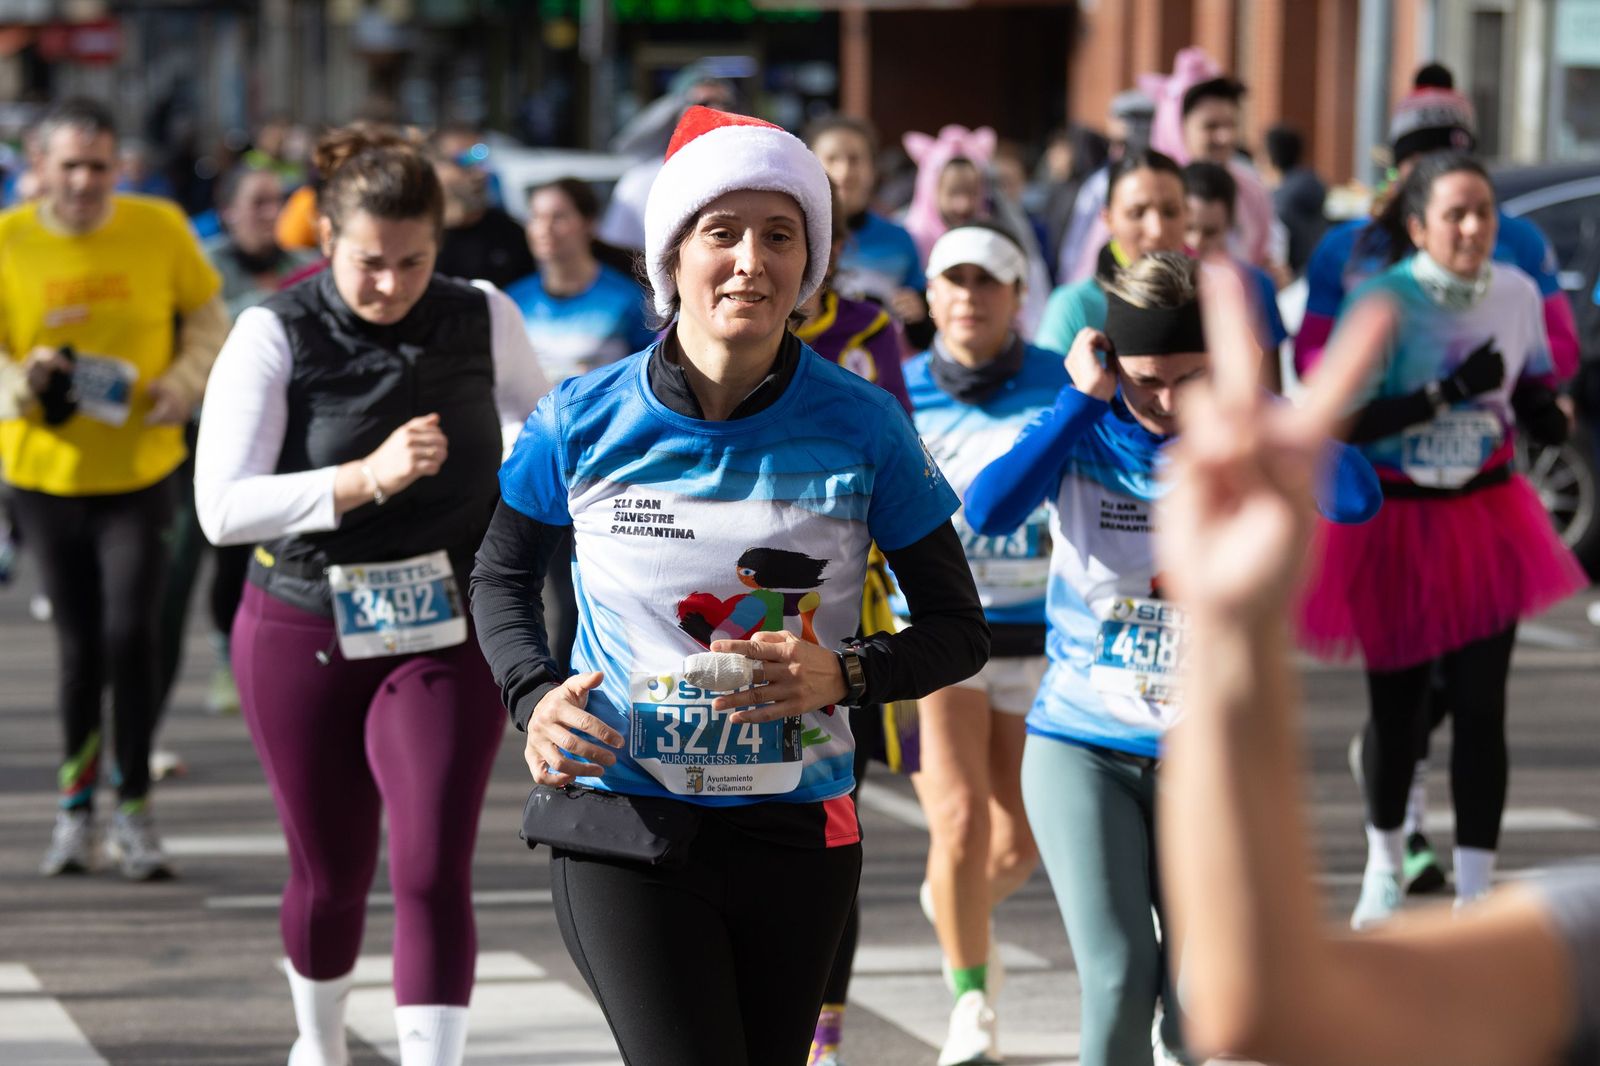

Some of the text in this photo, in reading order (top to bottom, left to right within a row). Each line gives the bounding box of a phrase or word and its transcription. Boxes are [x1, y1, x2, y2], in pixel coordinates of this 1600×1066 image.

[613, 499, 662, 510] XLI SAN
[613, 511, 675, 524] SILVESTRE
[610, 525, 696, 540] SALMANTINA
[352, 583, 438, 627] 3492
[1111, 622, 1186, 668] 458
[656, 706, 763, 755] 3274
[744, 754, 759, 764] 74
[707, 774, 754, 783] Ayuntamiento
[707, 783, 753, 792] de Salamanca
